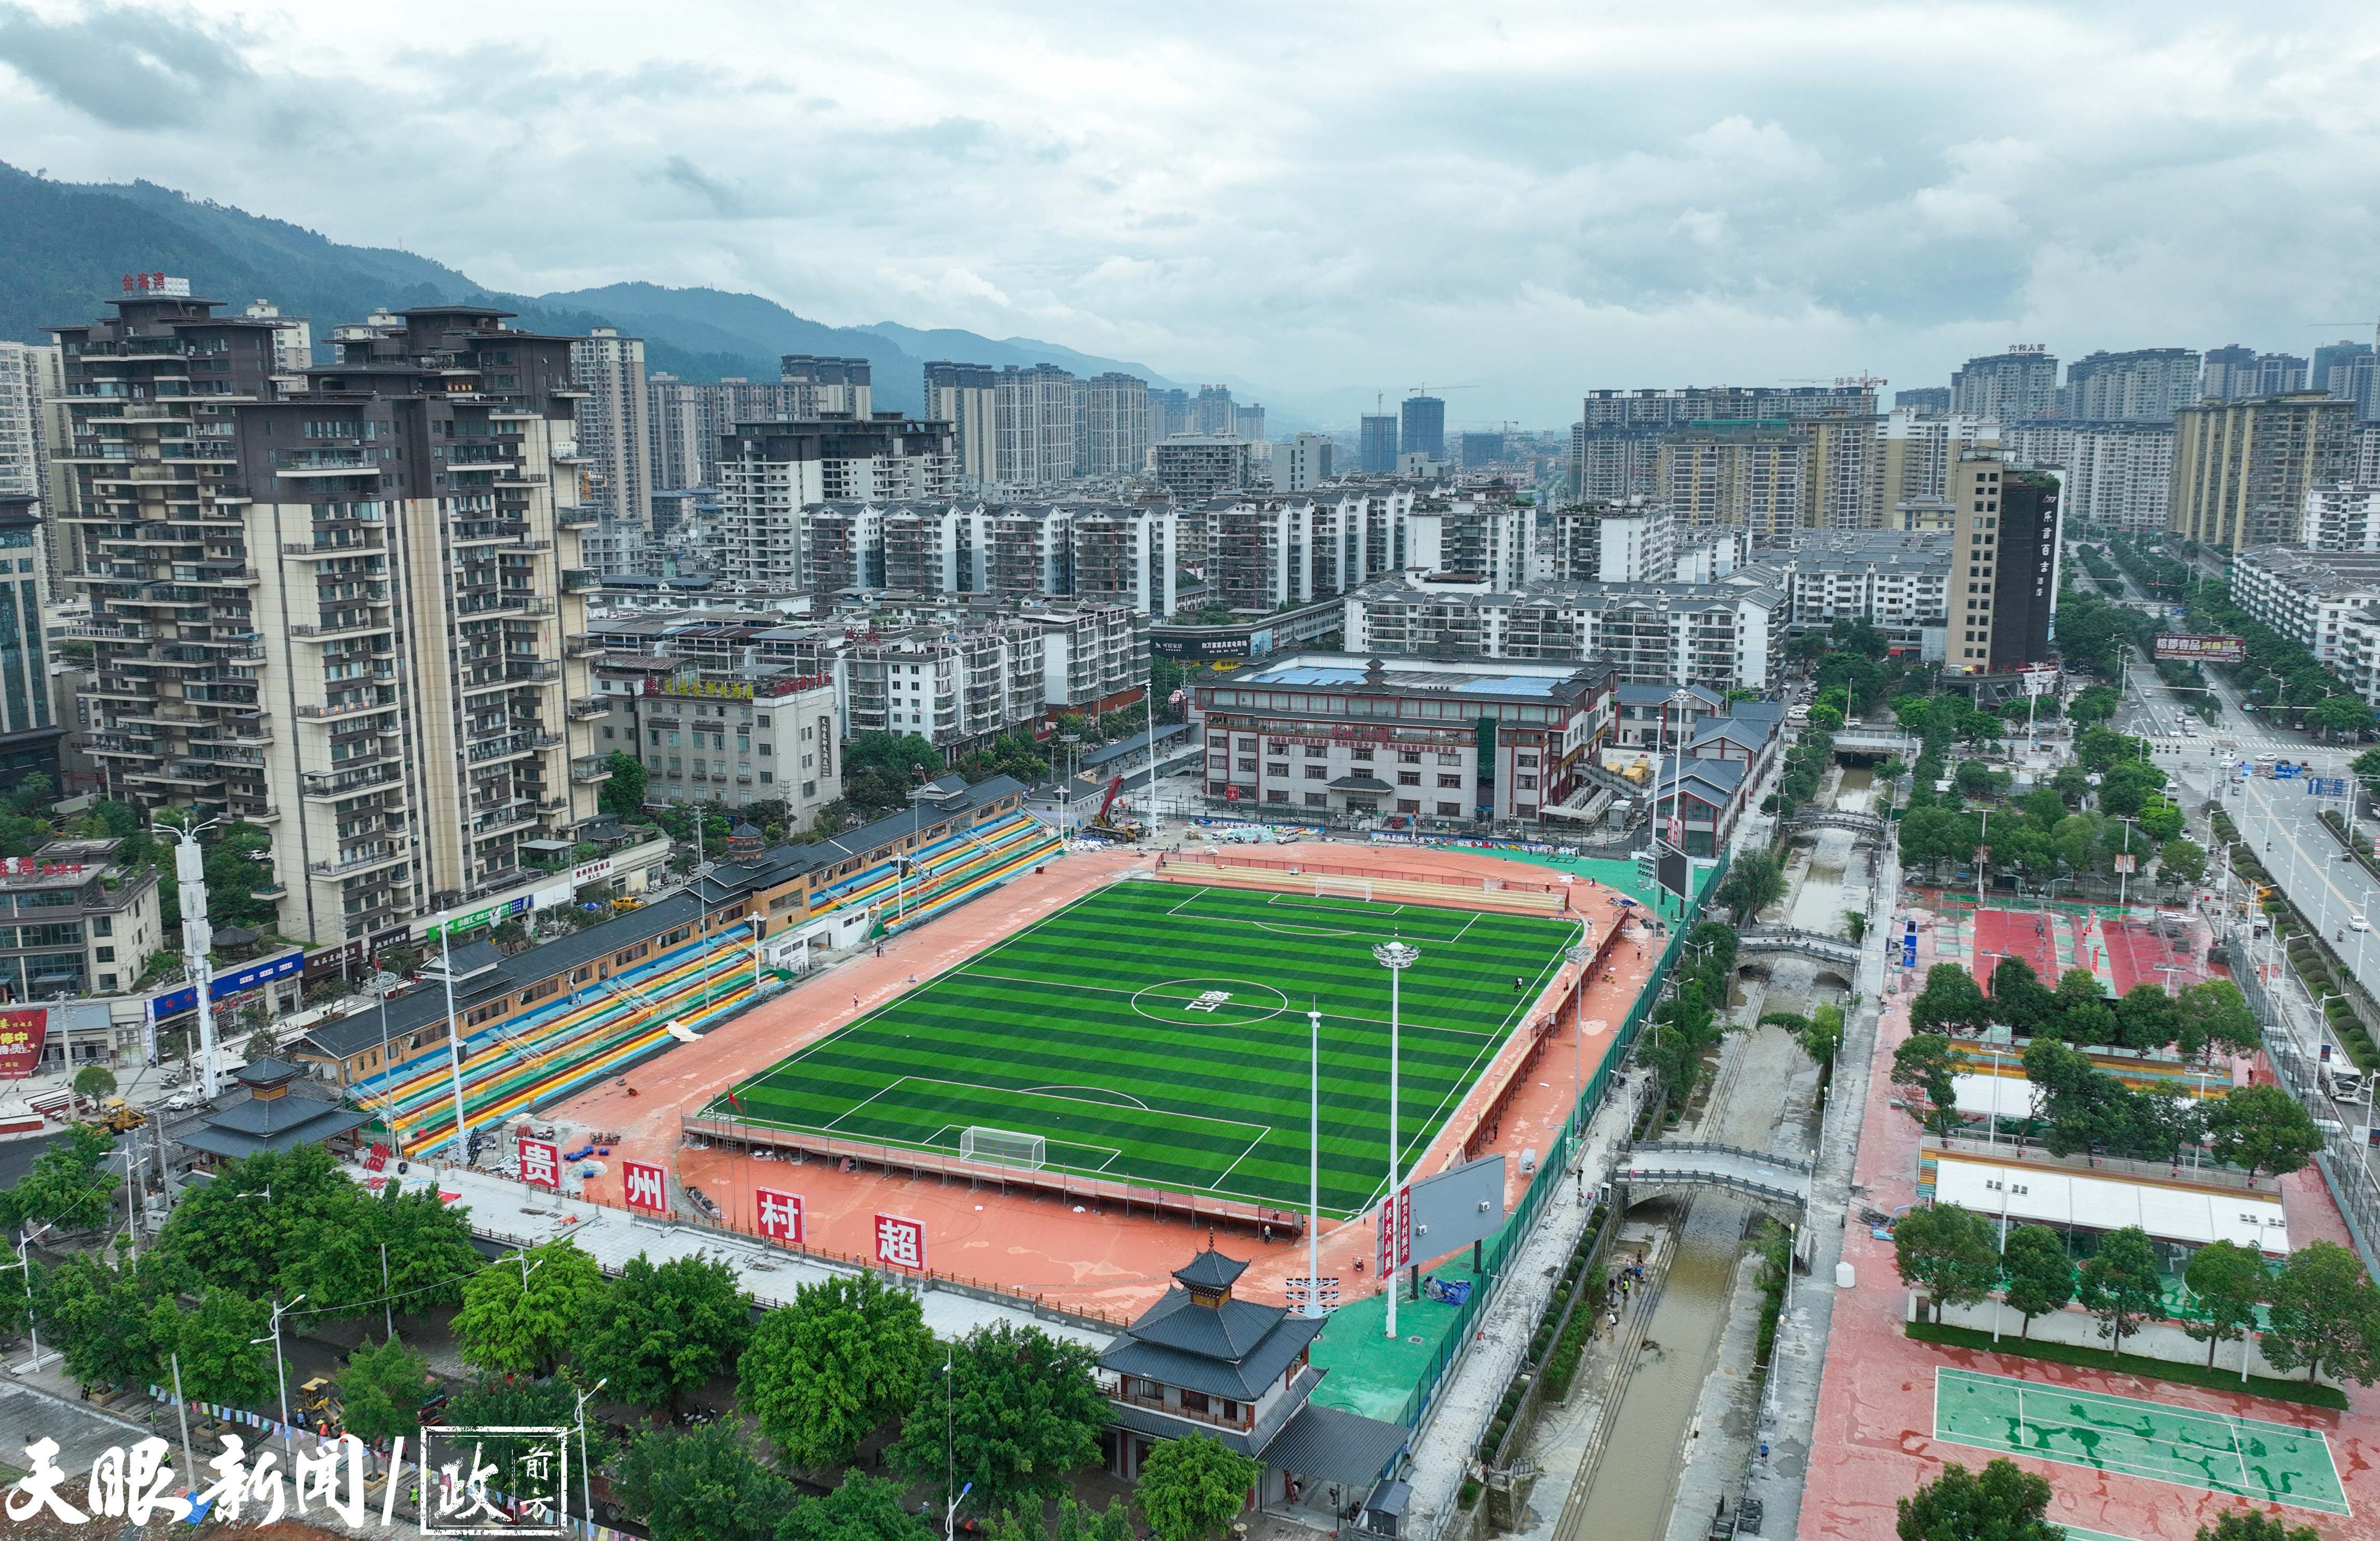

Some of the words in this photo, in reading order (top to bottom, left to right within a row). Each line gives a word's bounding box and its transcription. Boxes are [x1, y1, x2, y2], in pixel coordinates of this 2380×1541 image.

[121, 271, 165, 291] 金海湾
[521, 1141, 556, 1188] 贵
[627, 1167, 662, 1210] 州
[760, 1193, 798, 1240] 村
[877, 1219, 920, 1269] 超
